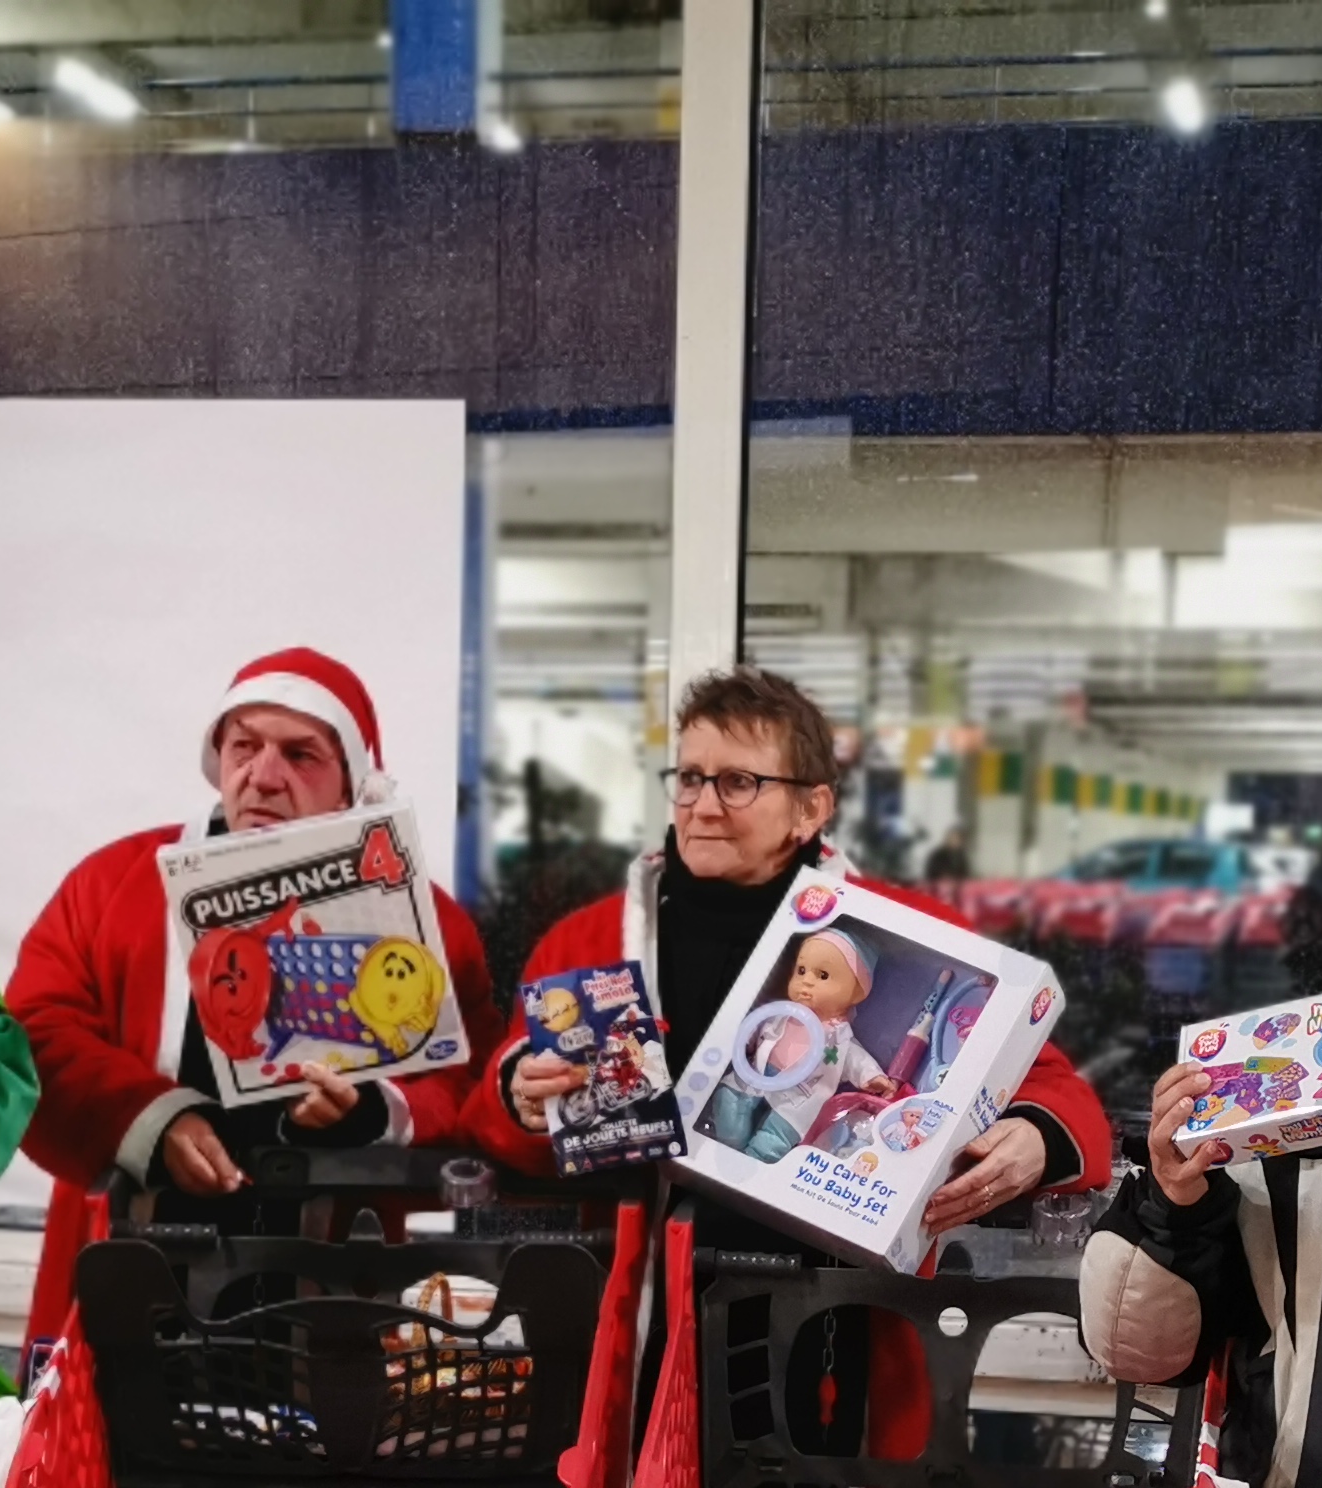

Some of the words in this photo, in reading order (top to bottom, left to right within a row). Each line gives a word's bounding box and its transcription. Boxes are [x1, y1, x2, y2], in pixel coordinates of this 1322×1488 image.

[193, 861, 358, 924] PUISSANCE
[360, 826, 405, 885] 4
[563, 1136, 581, 1149] DE
[582, 1127, 628, 1145] JOUETS
[629, 1121, 668, 1136] NEUFS
[600, 1119, 637, 1131] COLLECTE
[805, 1152, 830, 1173] My
[833, 1164, 868, 1186] Care
[824, 1180, 861, 1207] Baby
[863, 1197, 888, 1217] Set
